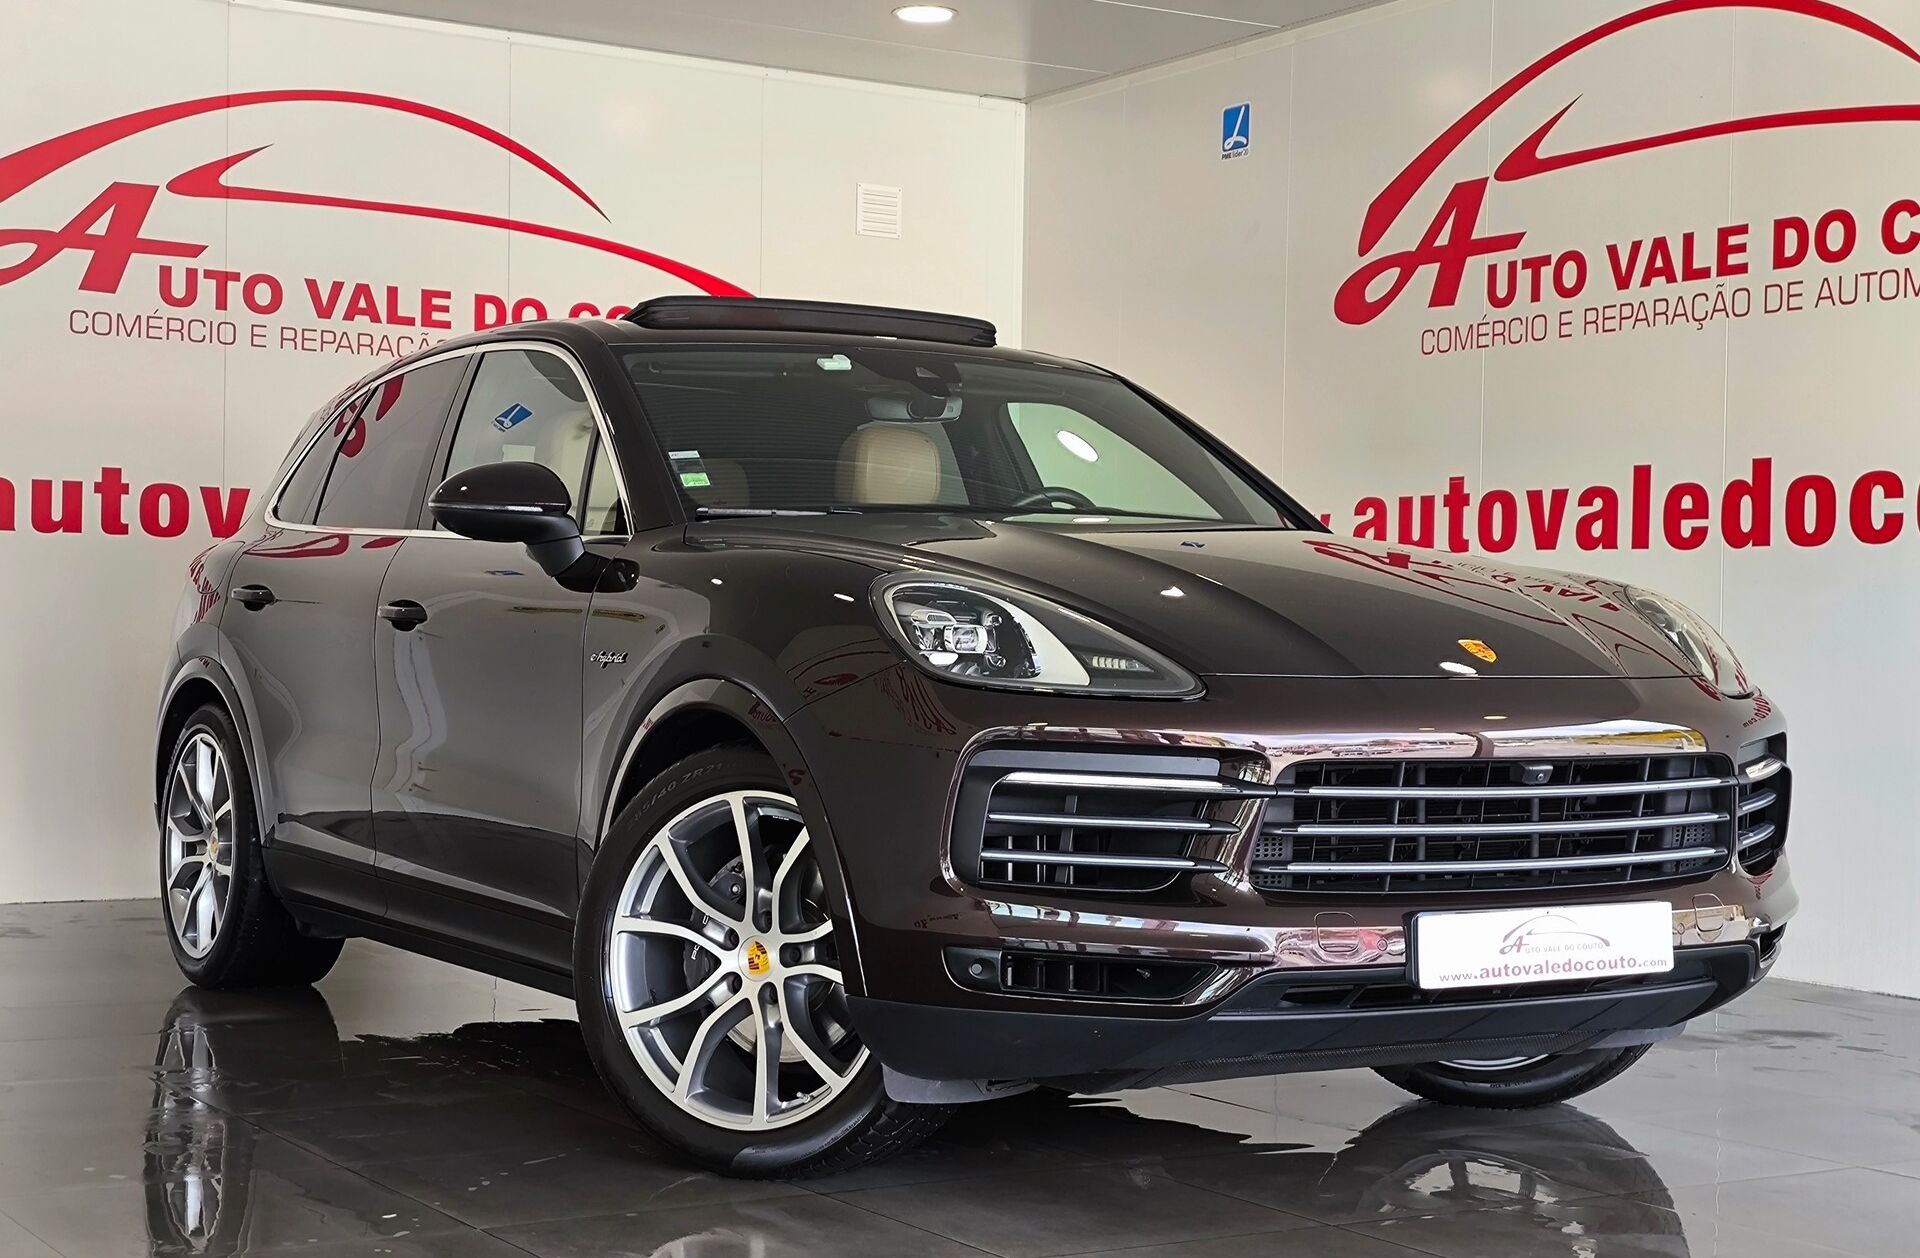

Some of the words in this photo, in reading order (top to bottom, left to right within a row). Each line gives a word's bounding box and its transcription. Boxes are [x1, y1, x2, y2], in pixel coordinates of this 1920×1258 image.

[0, 181, 284, 315] AUTO
[303, 278, 452, 330] VALE
[474, 293, 549, 332] DO
[1334, 176, 1588, 325] AUTO
[1605, 223, 1749, 291] VALE
[1772, 208, 1857, 270] DO
[69, 308, 237, 346] COMÉRCIO
[250, 323, 267, 348] E
[279, 325, 447, 358] REPARAÇÃ
[1420, 312, 1548, 356] COMÉRCIO
[1558, 310, 1574, 339] E
[1583, 282, 1751, 336] REPARAÇÃO
[1764, 280, 1804, 314] DE
[1439, 955, 1668, 983] www.autovaledocouto.com
[1564, 943, 1575, 952] DO
[1576, 942, 1604, 951] COUTO
